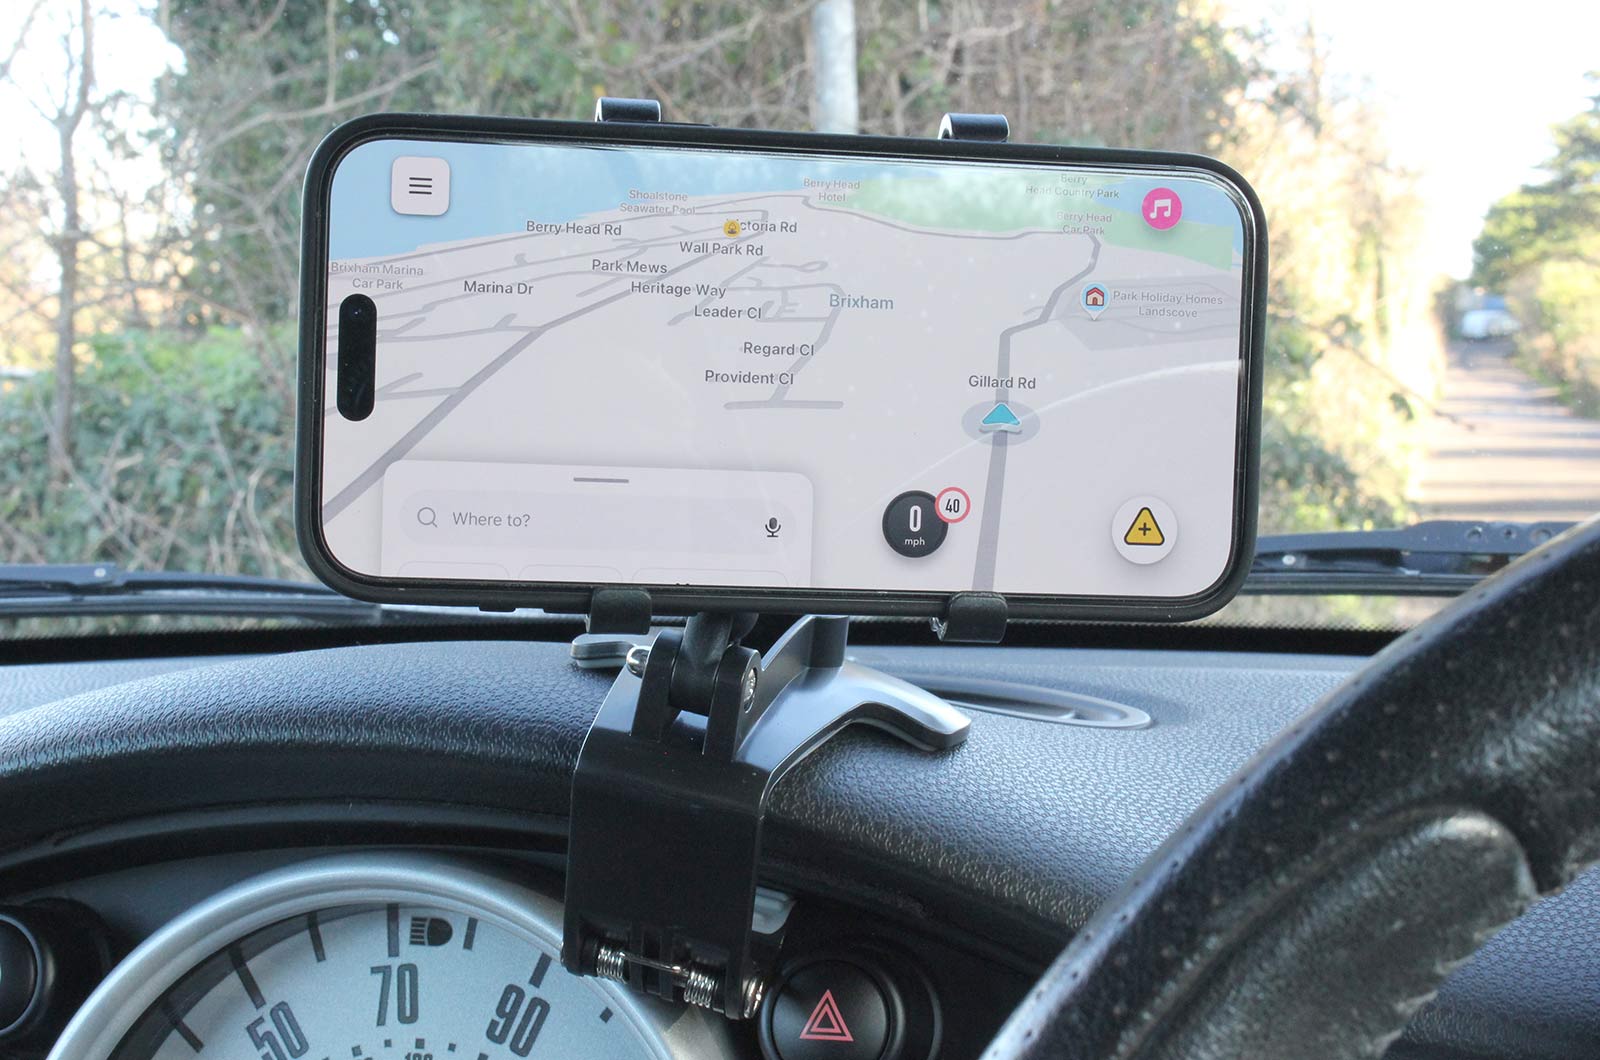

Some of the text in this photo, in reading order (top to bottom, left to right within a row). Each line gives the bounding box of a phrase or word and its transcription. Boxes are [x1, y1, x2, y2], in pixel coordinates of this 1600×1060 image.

[803, 178, 860, 190] Berry Head
[629, 189, 688, 201] Shoalstone
[818, 192, 846, 202] Hotel
[1055, 187, 1095, 199] Country
[1097, 188, 1120, 199] Park
[620, 202, 696, 216] Seawater Pool
[1086, 212, 1112, 223] Head
[526, 220, 622, 236] Berry Head Rd
[727, 219, 797, 233] ctoria Rd
[1062, 224, 1105, 236] Car Park
[679, 241, 764, 256] Wall Park Rd
[331, 261, 424, 276] Brixham Marina
[592, 259, 668, 274] Park Mews
[352, 278, 404, 290] Car Park
[464, 280, 534, 296] Marina Dr
[631, 281, 727, 299] Heritage Way
[829, 293, 895, 310] Brixham
[1113, 290, 1224, 305] Park Holiday Homes
[694, 306, 743, 320] Leader
[1138, 306, 1198, 319] Landscove
[743, 341, 796, 358] Regard
[704, 369, 775, 385] Provident
[968, 374, 1037, 390] Gillard Rd
[945, 498, 960, 513] 40
[452, 510, 531, 527] Where to?
[909, 505, 922, 532] 0
[904, 535, 926, 547] mph
[369, 962, 420, 1025] 70
[485, 983, 550, 1058] 90
[246, 1001, 310, 1060] 50
